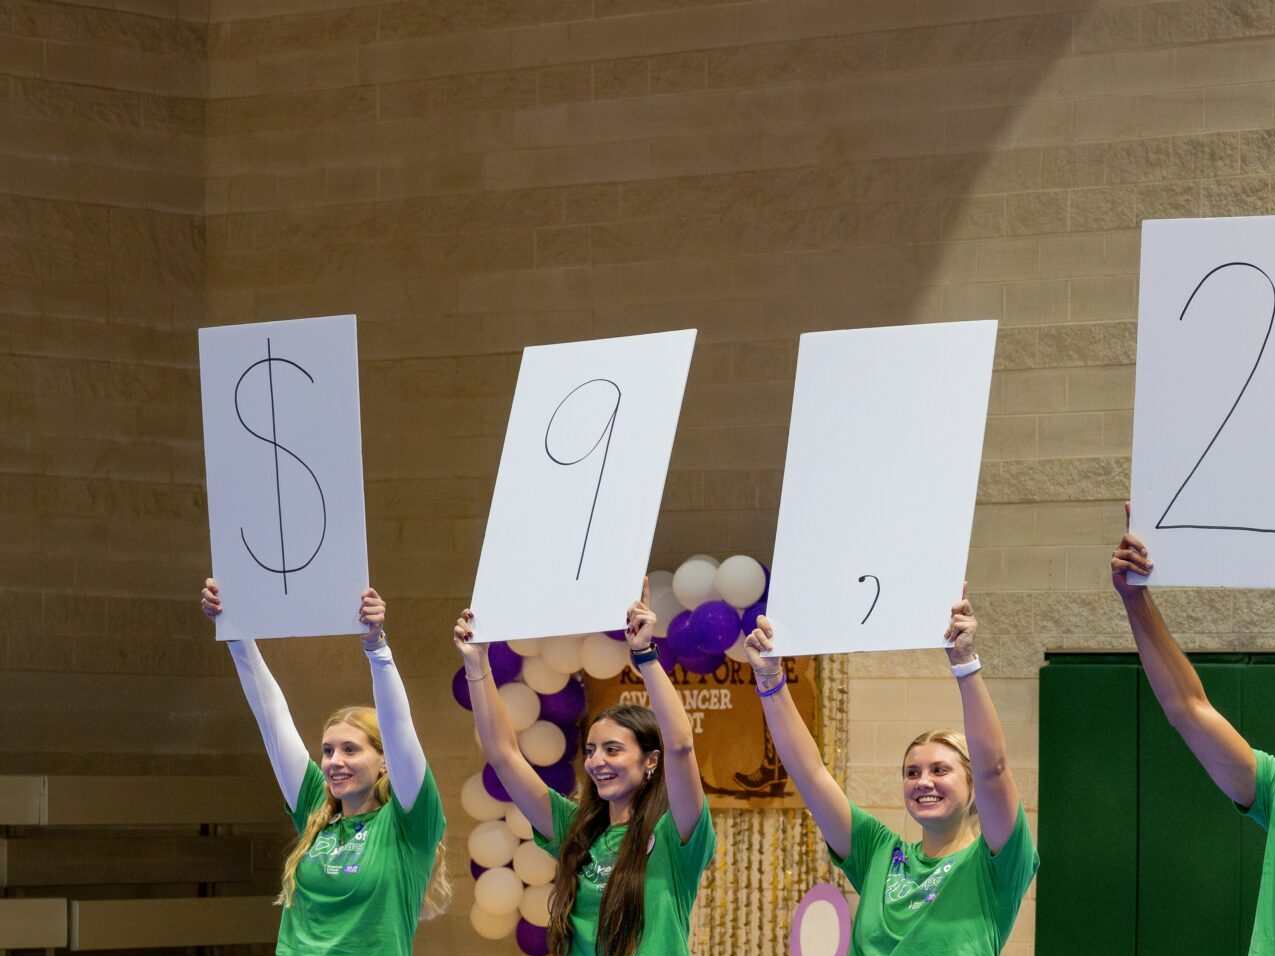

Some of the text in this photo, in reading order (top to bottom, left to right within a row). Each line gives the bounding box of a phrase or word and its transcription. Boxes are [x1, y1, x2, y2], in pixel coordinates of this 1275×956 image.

[235, 338, 326, 595] $
[545, 379, 621, 581] 9
[858, 575, 880, 624] ,
